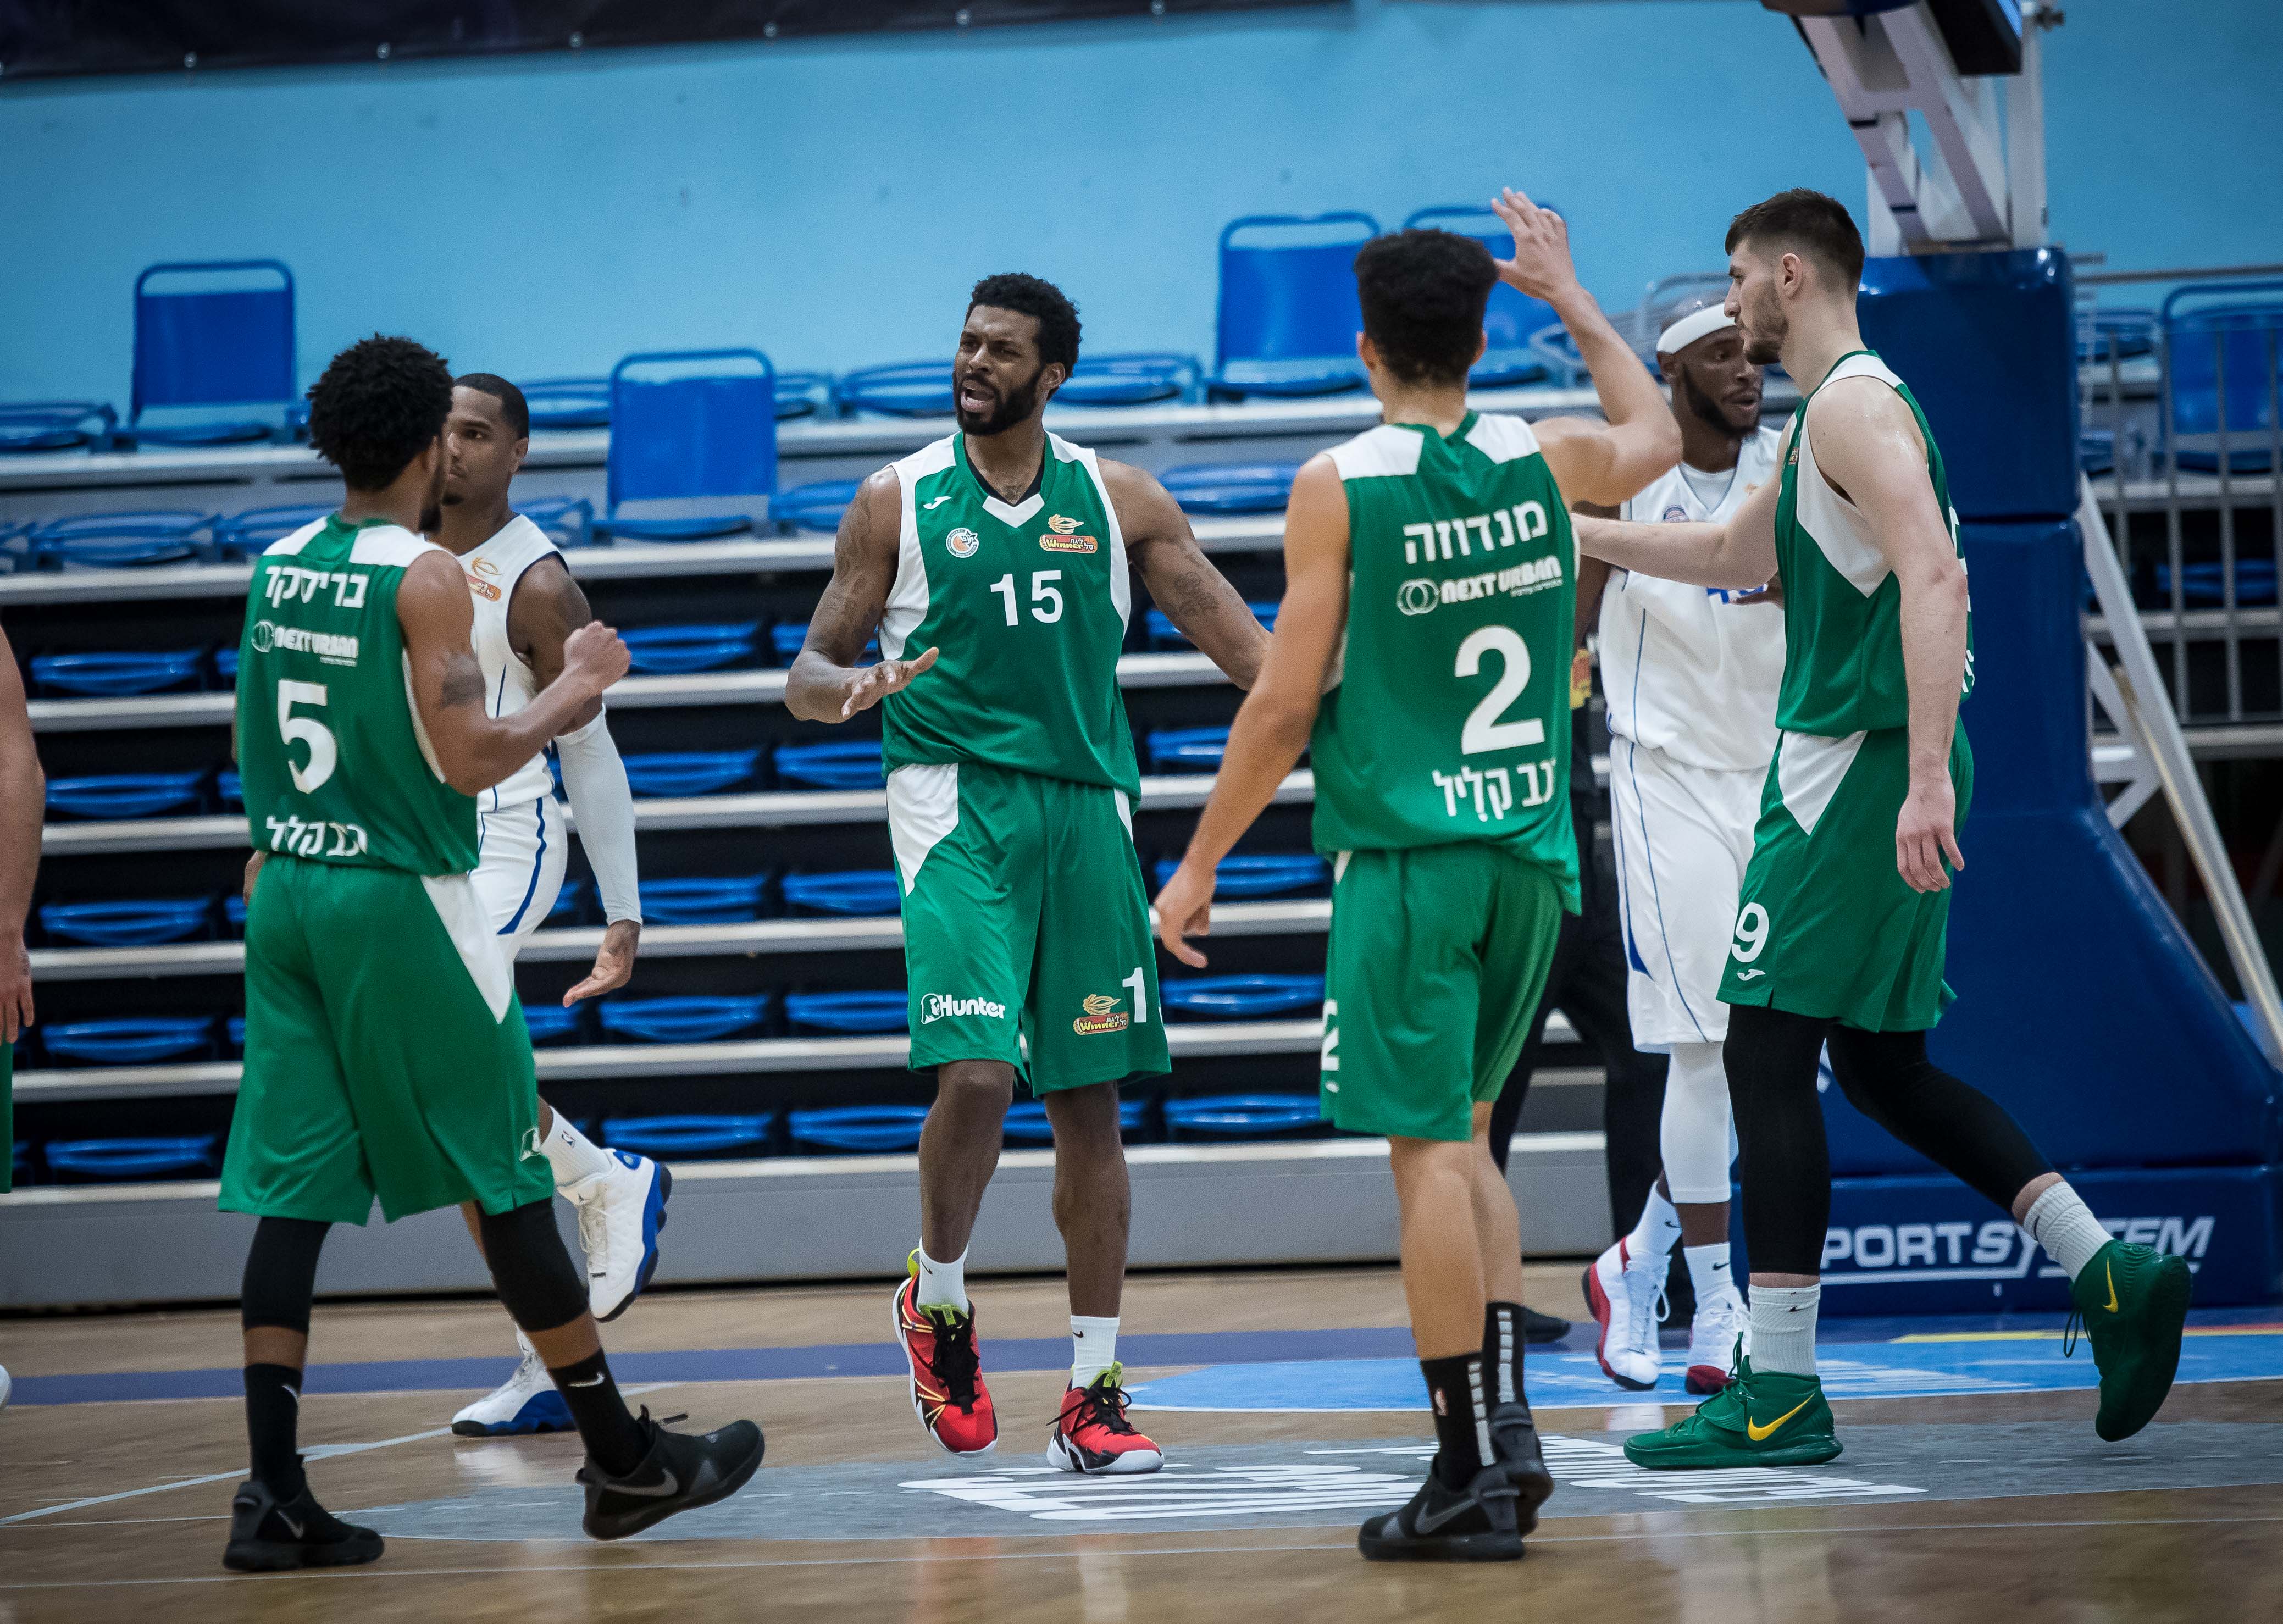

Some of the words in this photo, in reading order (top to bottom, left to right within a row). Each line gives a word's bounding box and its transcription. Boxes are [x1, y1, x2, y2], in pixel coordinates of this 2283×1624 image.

[1046, 539, 1084, 550] Winner
[1403, 500, 1548, 564] מנדוזה
[990, 570, 1063, 627] 15
[1454, 625, 1545, 755] 2
[277, 679, 336, 795] 5
[1432, 765, 1512, 822] קליל
[1732, 902, 1770, 963] 9
[938, 994, 1006, 1019] Hunter
[1079, 1021, 1118, 1032] Winner
